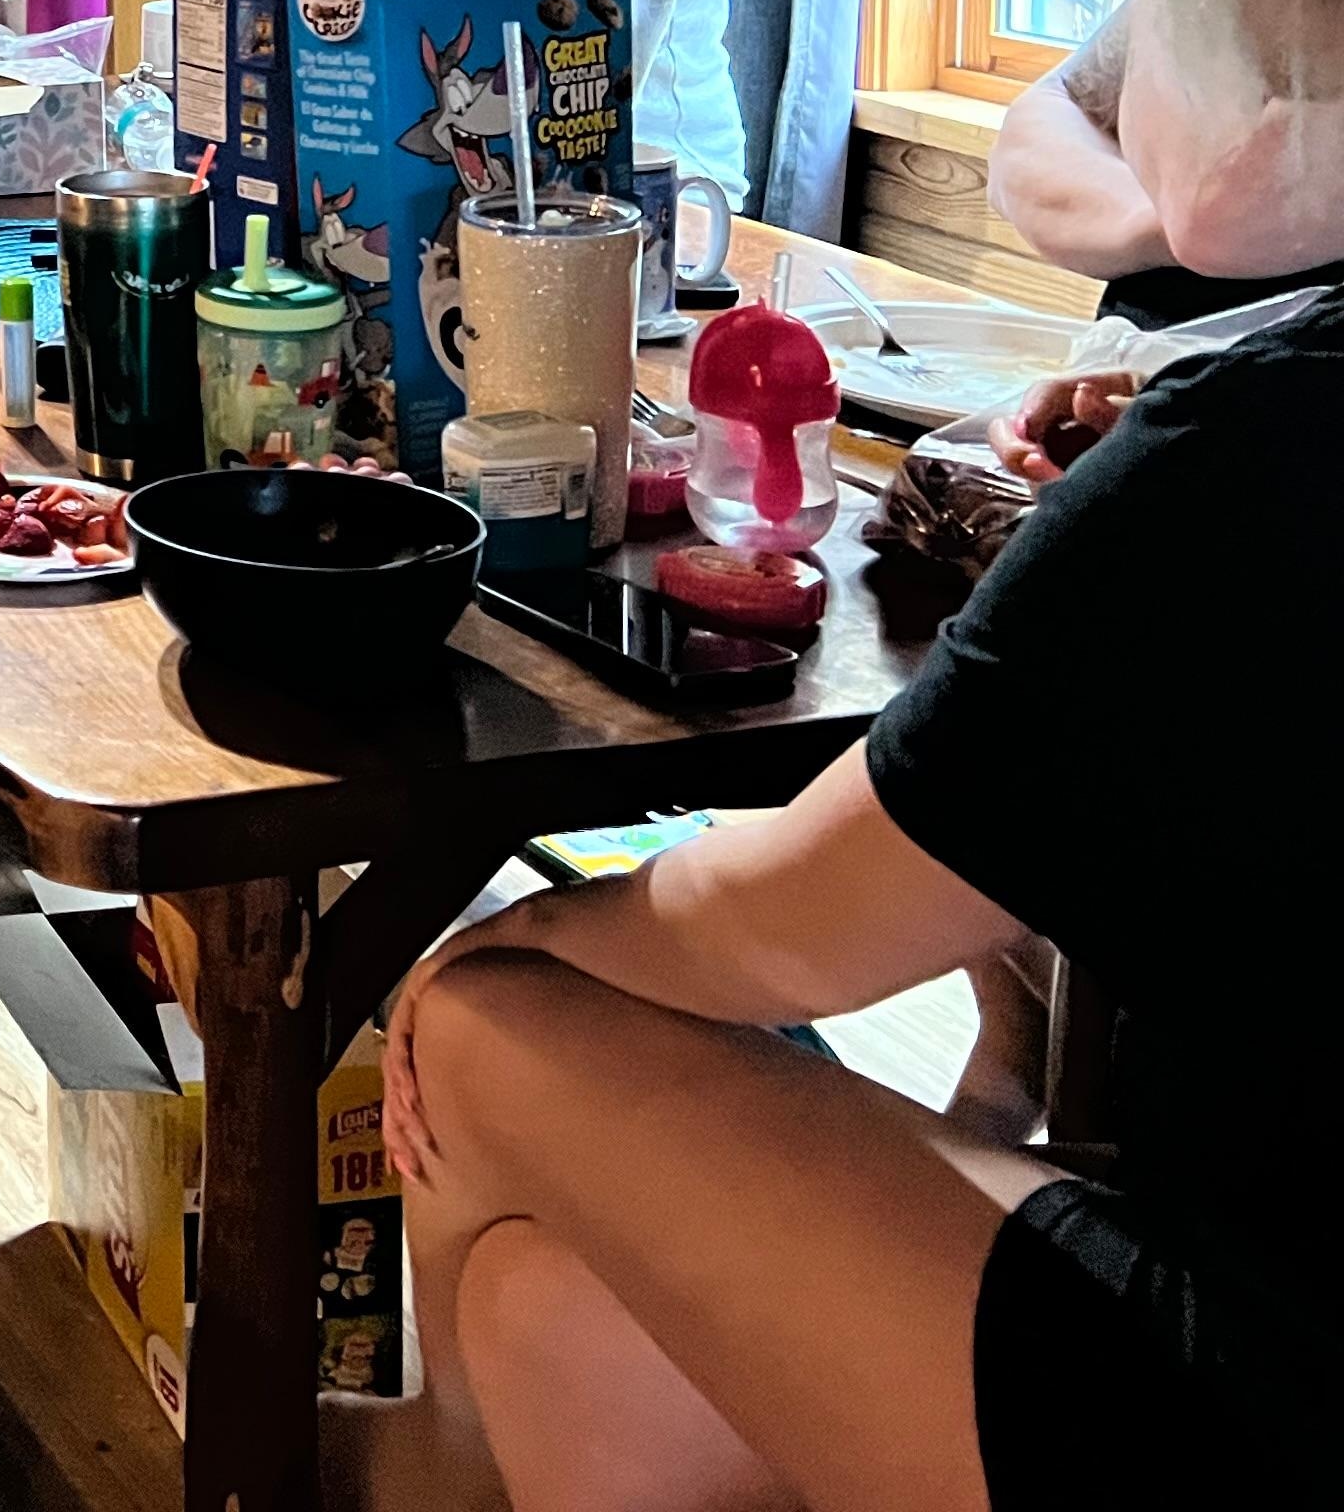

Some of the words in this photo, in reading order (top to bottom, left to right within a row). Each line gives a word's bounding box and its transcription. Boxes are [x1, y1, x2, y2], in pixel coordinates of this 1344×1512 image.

[545, 34, 607, 71] GREAT
[550, 64, 608, 85] CHOCOLATE
[553, 78, 609, 116] CHIP
[557, 133, 607, 160] TASTE!
[337, 1107, 379, 1137] Lay's
